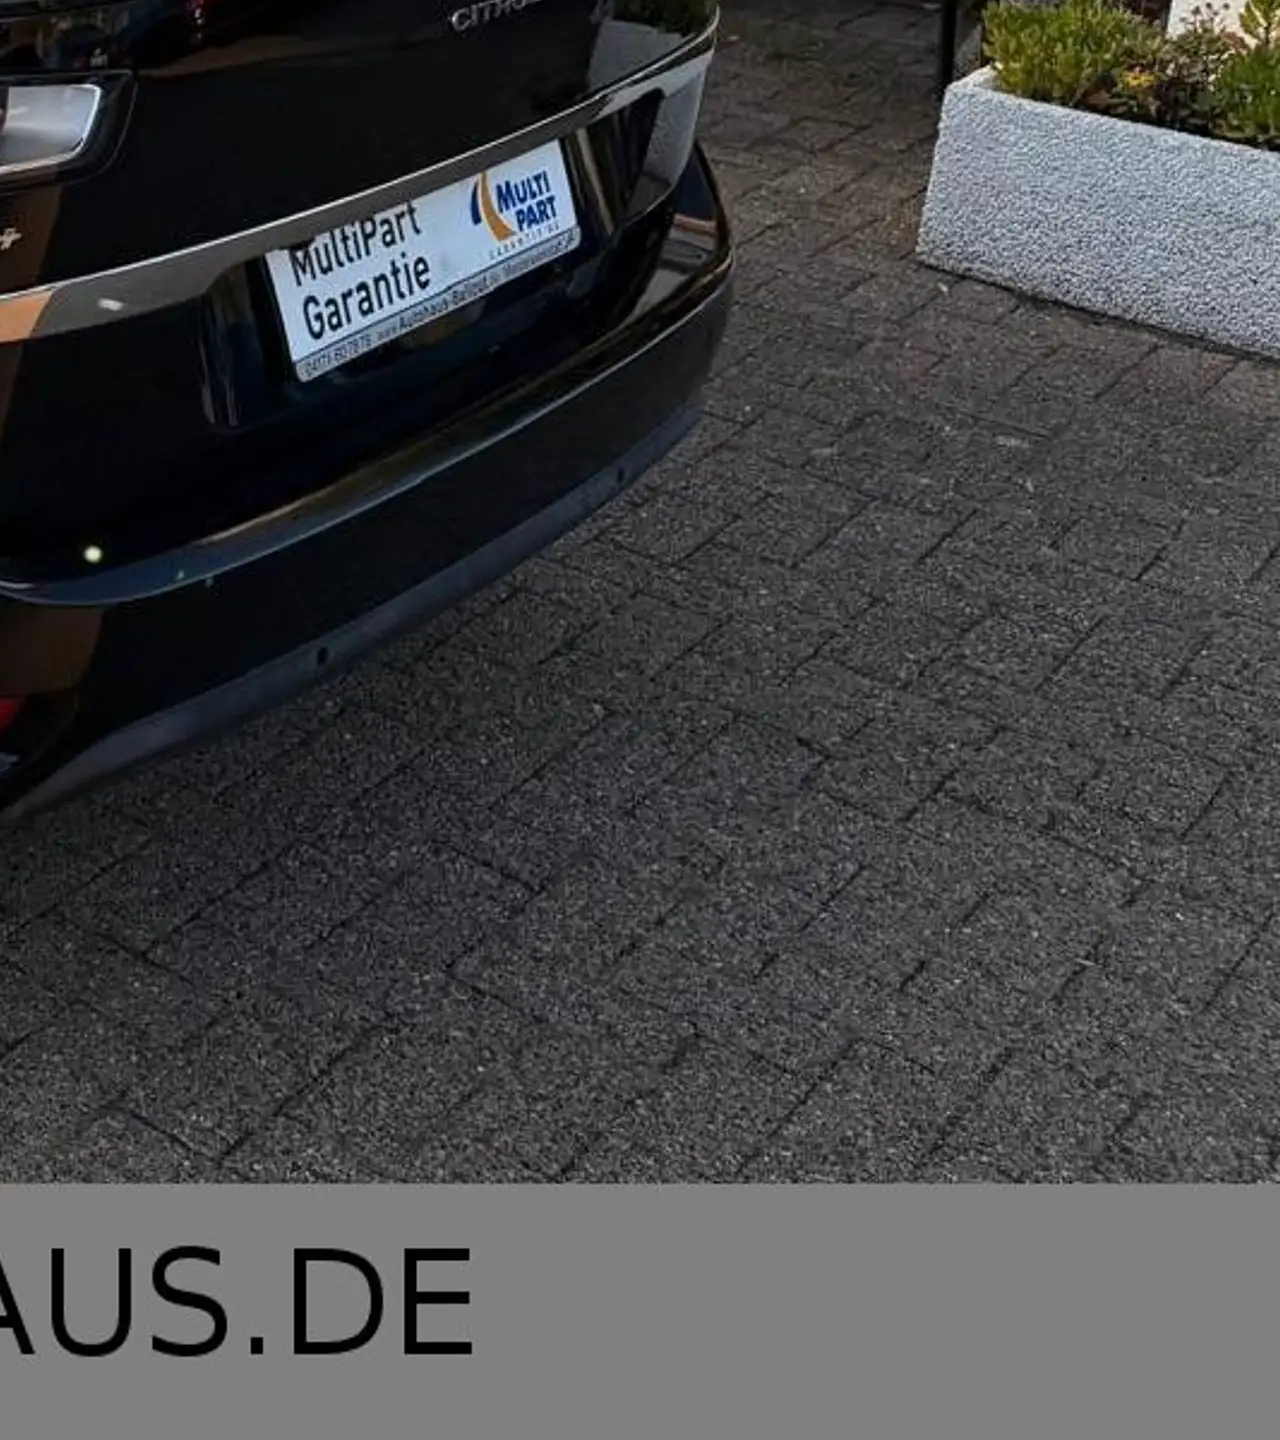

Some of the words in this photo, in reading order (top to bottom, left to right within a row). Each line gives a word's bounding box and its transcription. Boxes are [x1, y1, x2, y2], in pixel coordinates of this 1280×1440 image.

[288, 200, 422, 286] MultiPart
[515, 196, 559, 233] PART
[302, 252, 431, 340] Garantie
